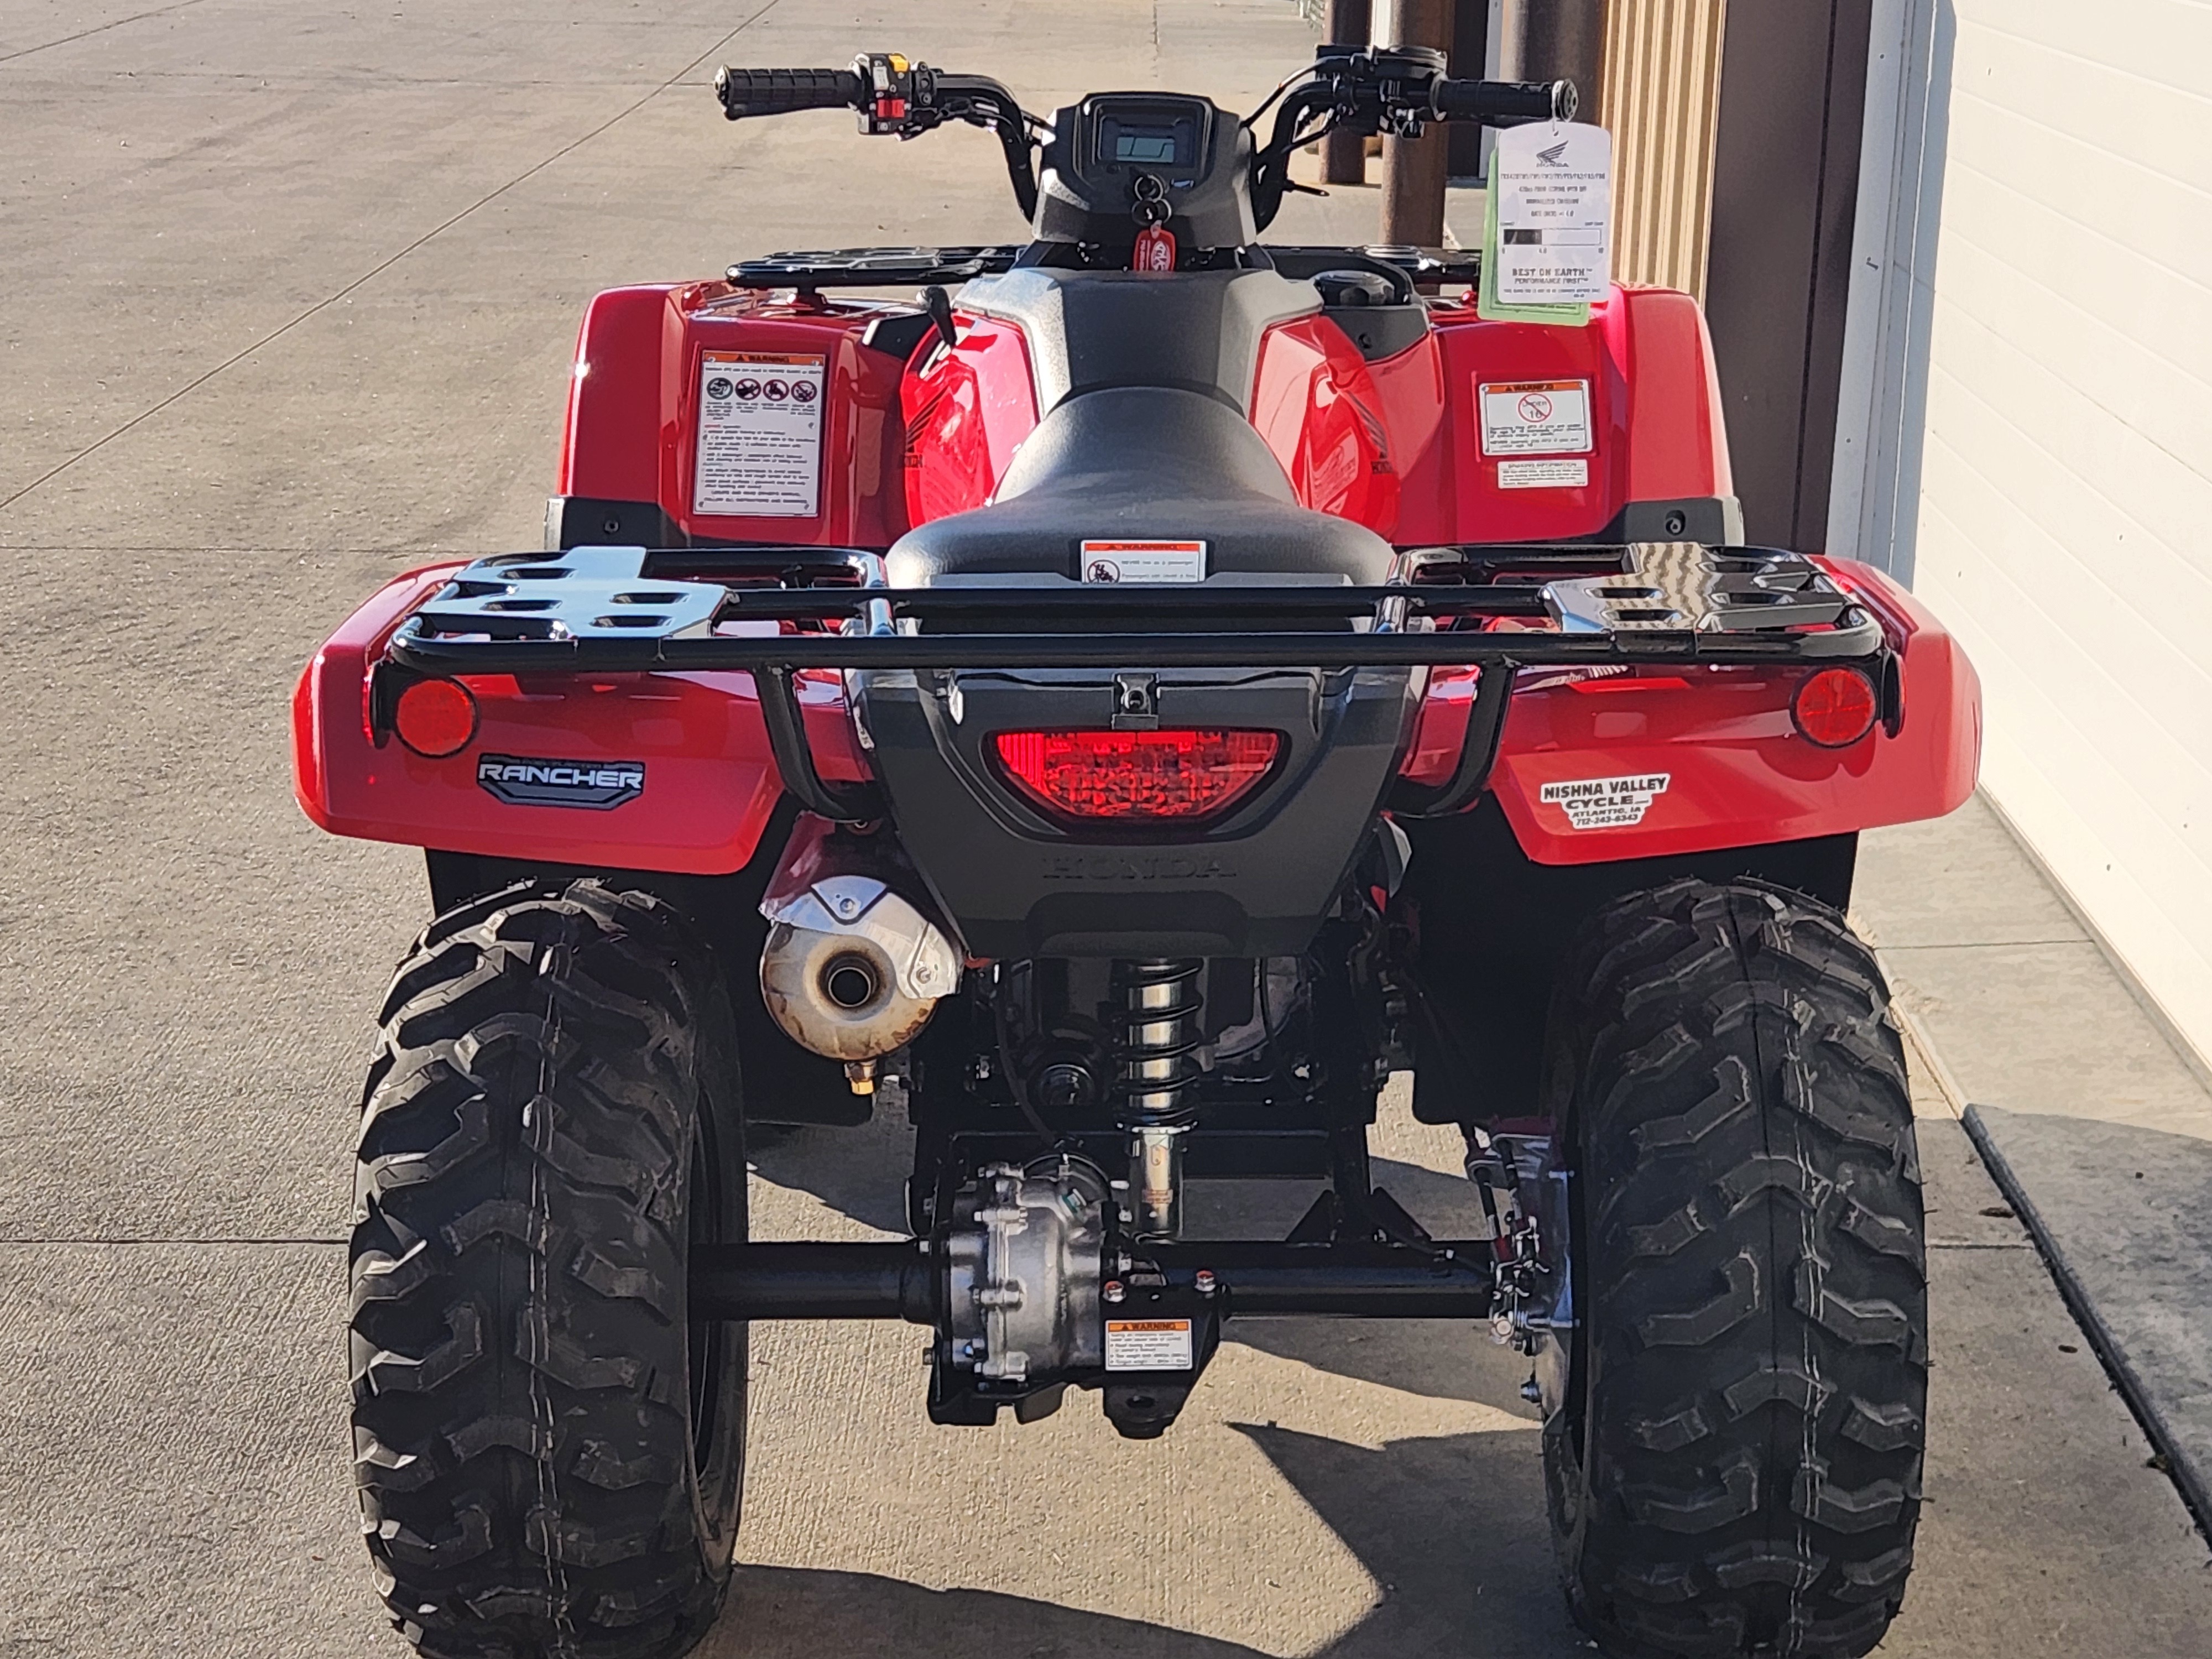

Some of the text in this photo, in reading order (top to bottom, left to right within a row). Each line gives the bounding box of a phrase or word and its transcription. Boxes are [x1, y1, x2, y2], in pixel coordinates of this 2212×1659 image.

[1512, 268, 1536, 276] BEST
[1538, 268, 1552, 276] ON
[478, 763, 643, 789] RANCHER
[1544, 776, 1667, 800] NISHNA VALLEY
[1565, 795, 1634, 810] CYCLE
[1042, 857, 1237, 879] HONDA
